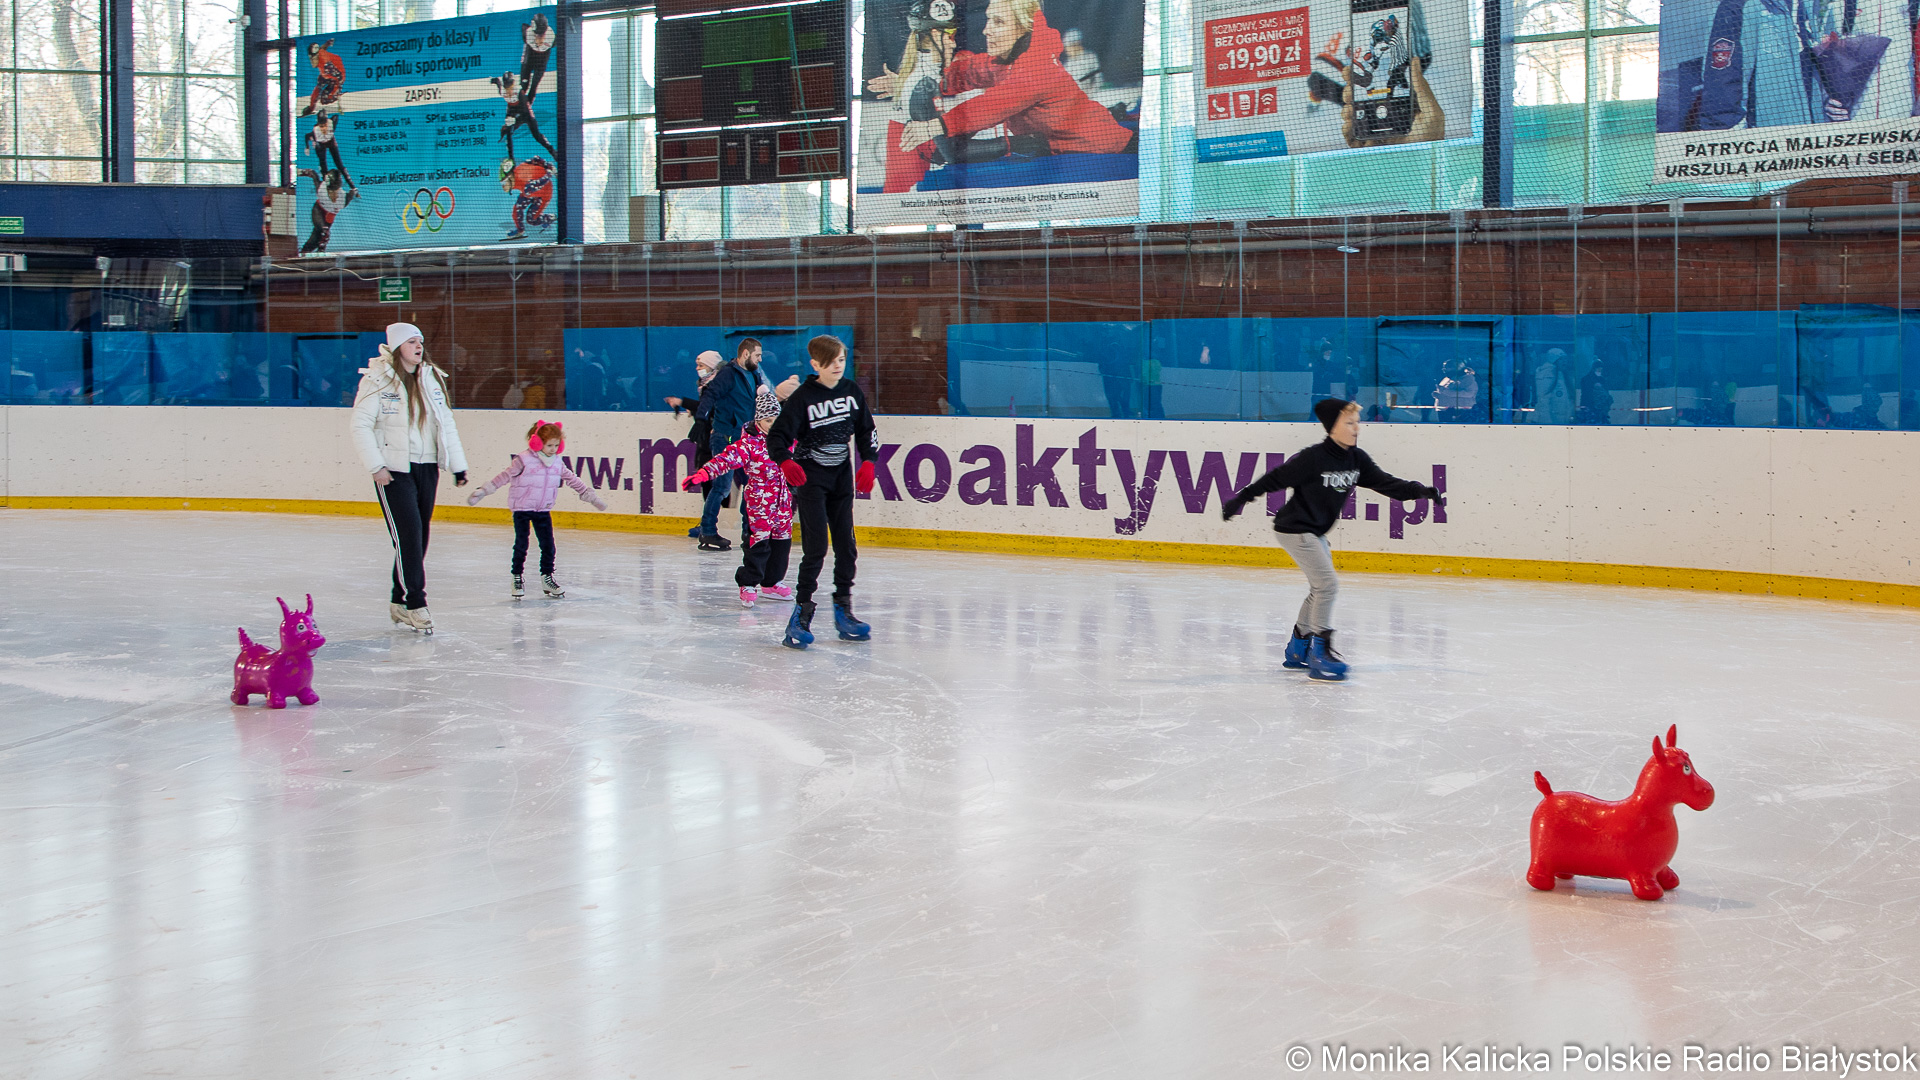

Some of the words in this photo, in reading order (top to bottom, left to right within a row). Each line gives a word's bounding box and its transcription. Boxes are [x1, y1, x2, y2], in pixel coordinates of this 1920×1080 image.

[1212, 21, 1258, 34] ROZMOWY,
[1259, 18, 1278, 29] SMS
[1285, 14, 1305, 25] MMS
[357, 37, 424, 58] Zapraszamy
[427, 32, 442, 48] do
[445, 29, 475, 47] klasy
[479, 26, 490, 41] IV
[1215, 36, 1234, 47] BEZ
[1236, 24, 1303, 45] OGRANICZEŃ
[1226, 44, 1281, 70] 19,90
[1284, 39, 1302, 62] zł
[365, 67, 373, 79] o
[376, 60, 412, 82] profilu
[416, 54, 482, 77] sportowym
[1257, 65, 1300, 78] MIESIĘCZNIE
[405, 87, 442, 103] ZAPISY:
[1685, 140, 1779, 157] PATRYCJA
[1665, 162, 1748, 178] URSZULĄ
[1754, 153, 1849, 173] KAMIŃSKĄ
[1856, 153, 1862, 165] I
[1867, 149, 1920, 165] SEBA
[360, 172, 387, 185] Zostań
[389, 171, 425, 183] Mistrzem
[436, 165, 490, 180] Short-Tracku
[1028, 193, 1056, 202] Urszulą
[1059, 190, 1100, 200] Kamińską
[807, 396, 859, 421] NASA
